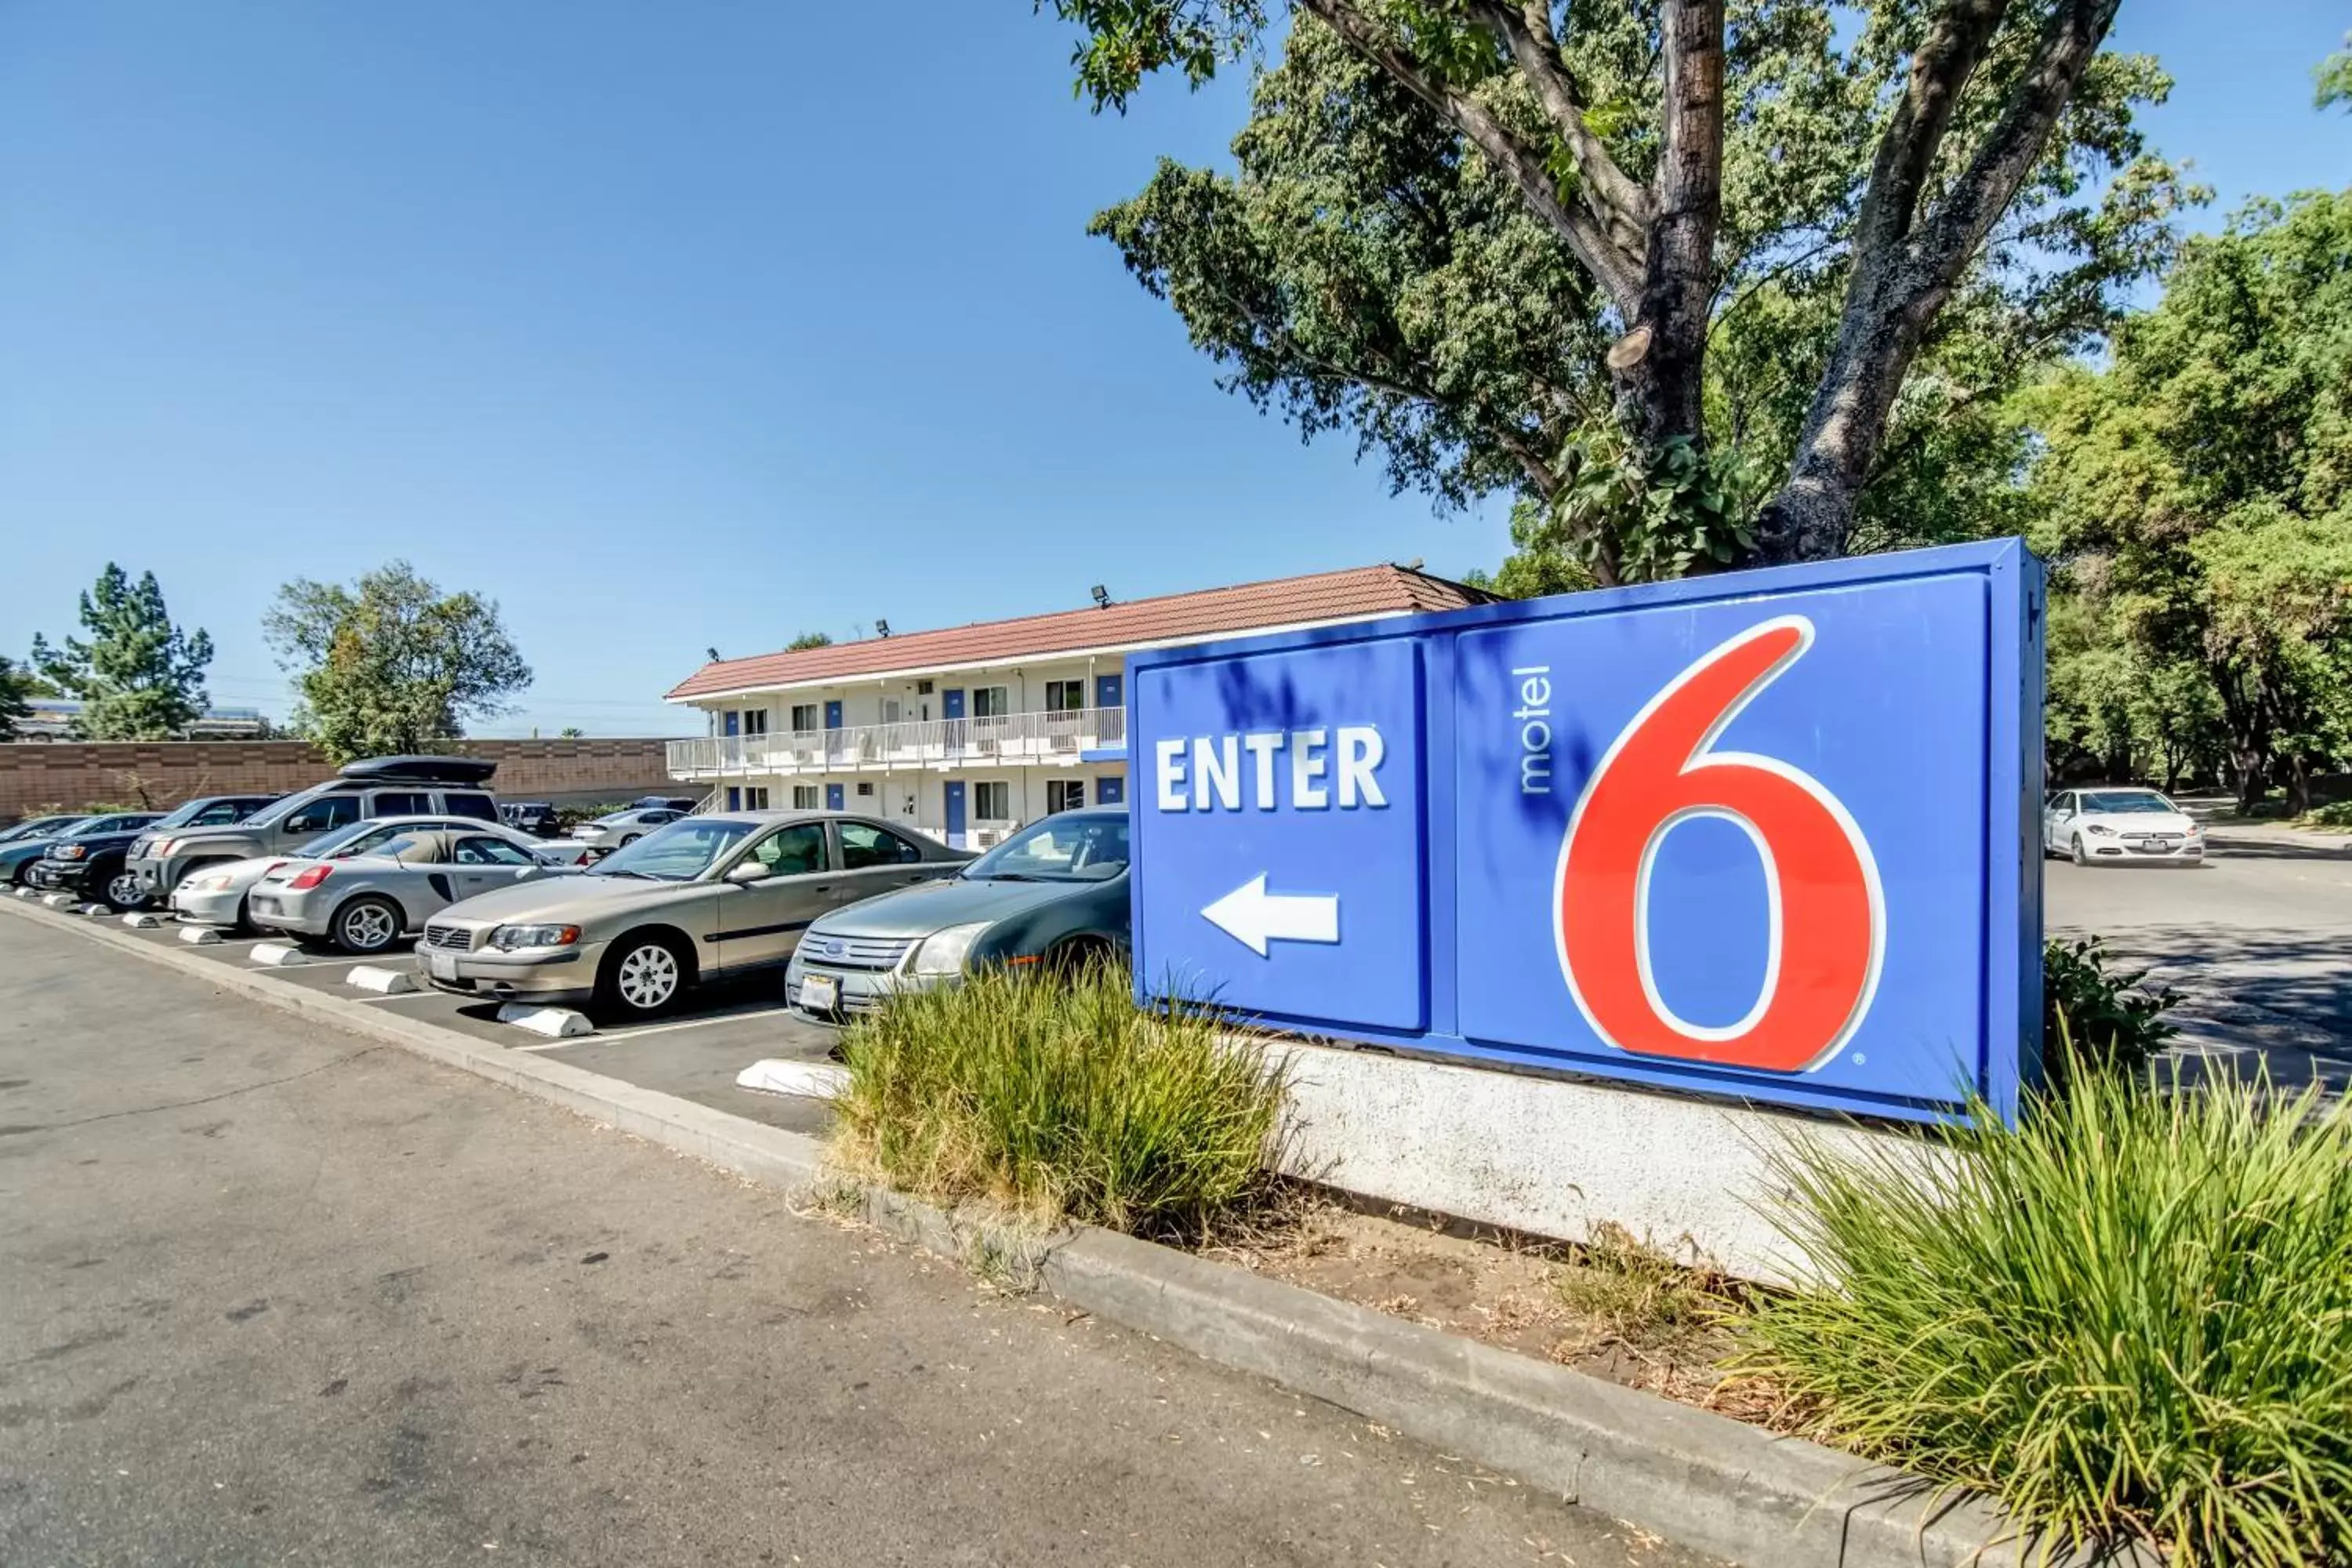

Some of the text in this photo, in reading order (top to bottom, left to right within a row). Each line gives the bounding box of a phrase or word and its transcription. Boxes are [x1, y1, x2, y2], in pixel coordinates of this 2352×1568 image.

[1156, 724, 1388, 811] ENTER
[1511, 665, 1552, 793] motel
[1553, 614, 1886, 1073] 6
